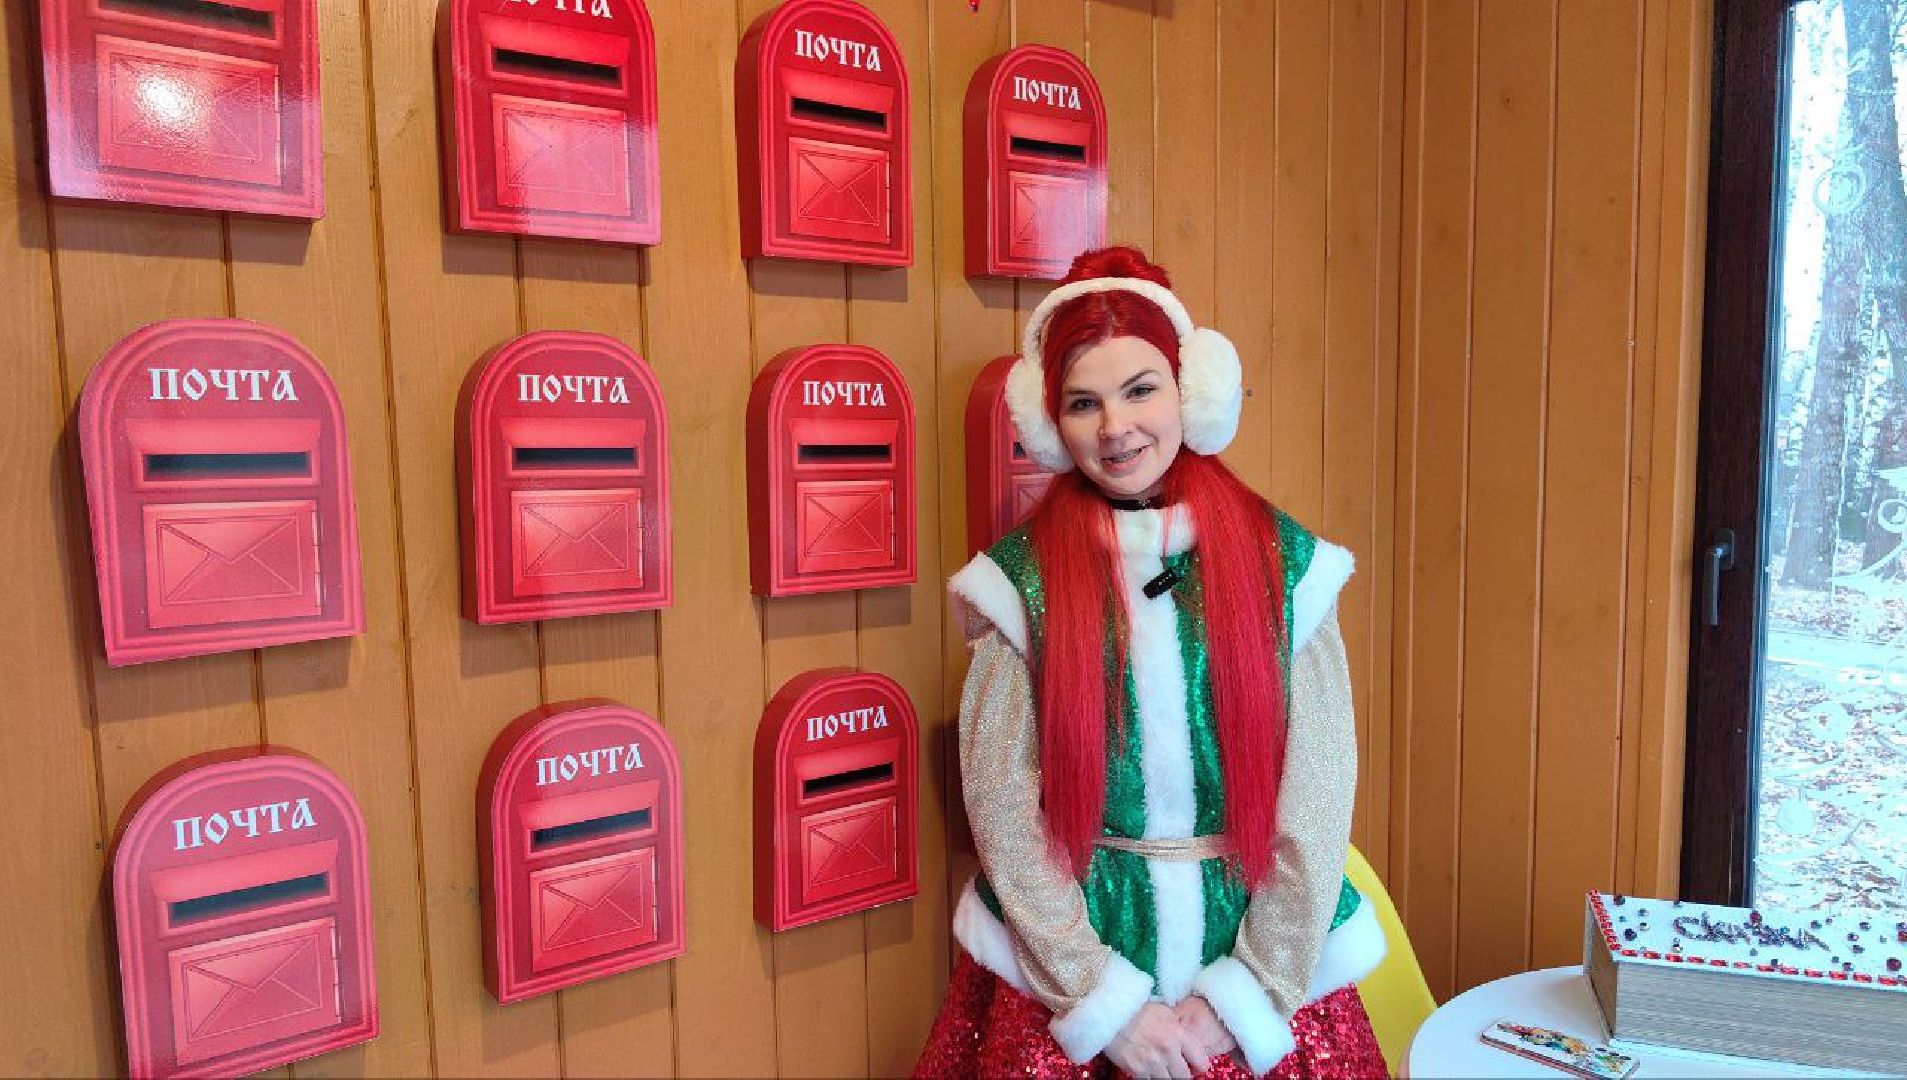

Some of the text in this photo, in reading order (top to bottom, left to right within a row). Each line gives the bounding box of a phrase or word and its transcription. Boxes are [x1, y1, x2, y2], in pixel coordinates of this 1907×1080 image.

[795, 30, 882, 72] ПОЧТА
[1013, 76, 1081, 110] ПОЧТА
[147, 368, 300, 401] ПОЧТА
[518, 374, 631, 404] ПОЧТА
[802, 380, 886, 407] ПОЧТА
[806, 705, 889, 741] ПОЧТА
[535, 742, 644, 786] ПОЧТА
[171, 797, 318, 851] ПОЧТА
